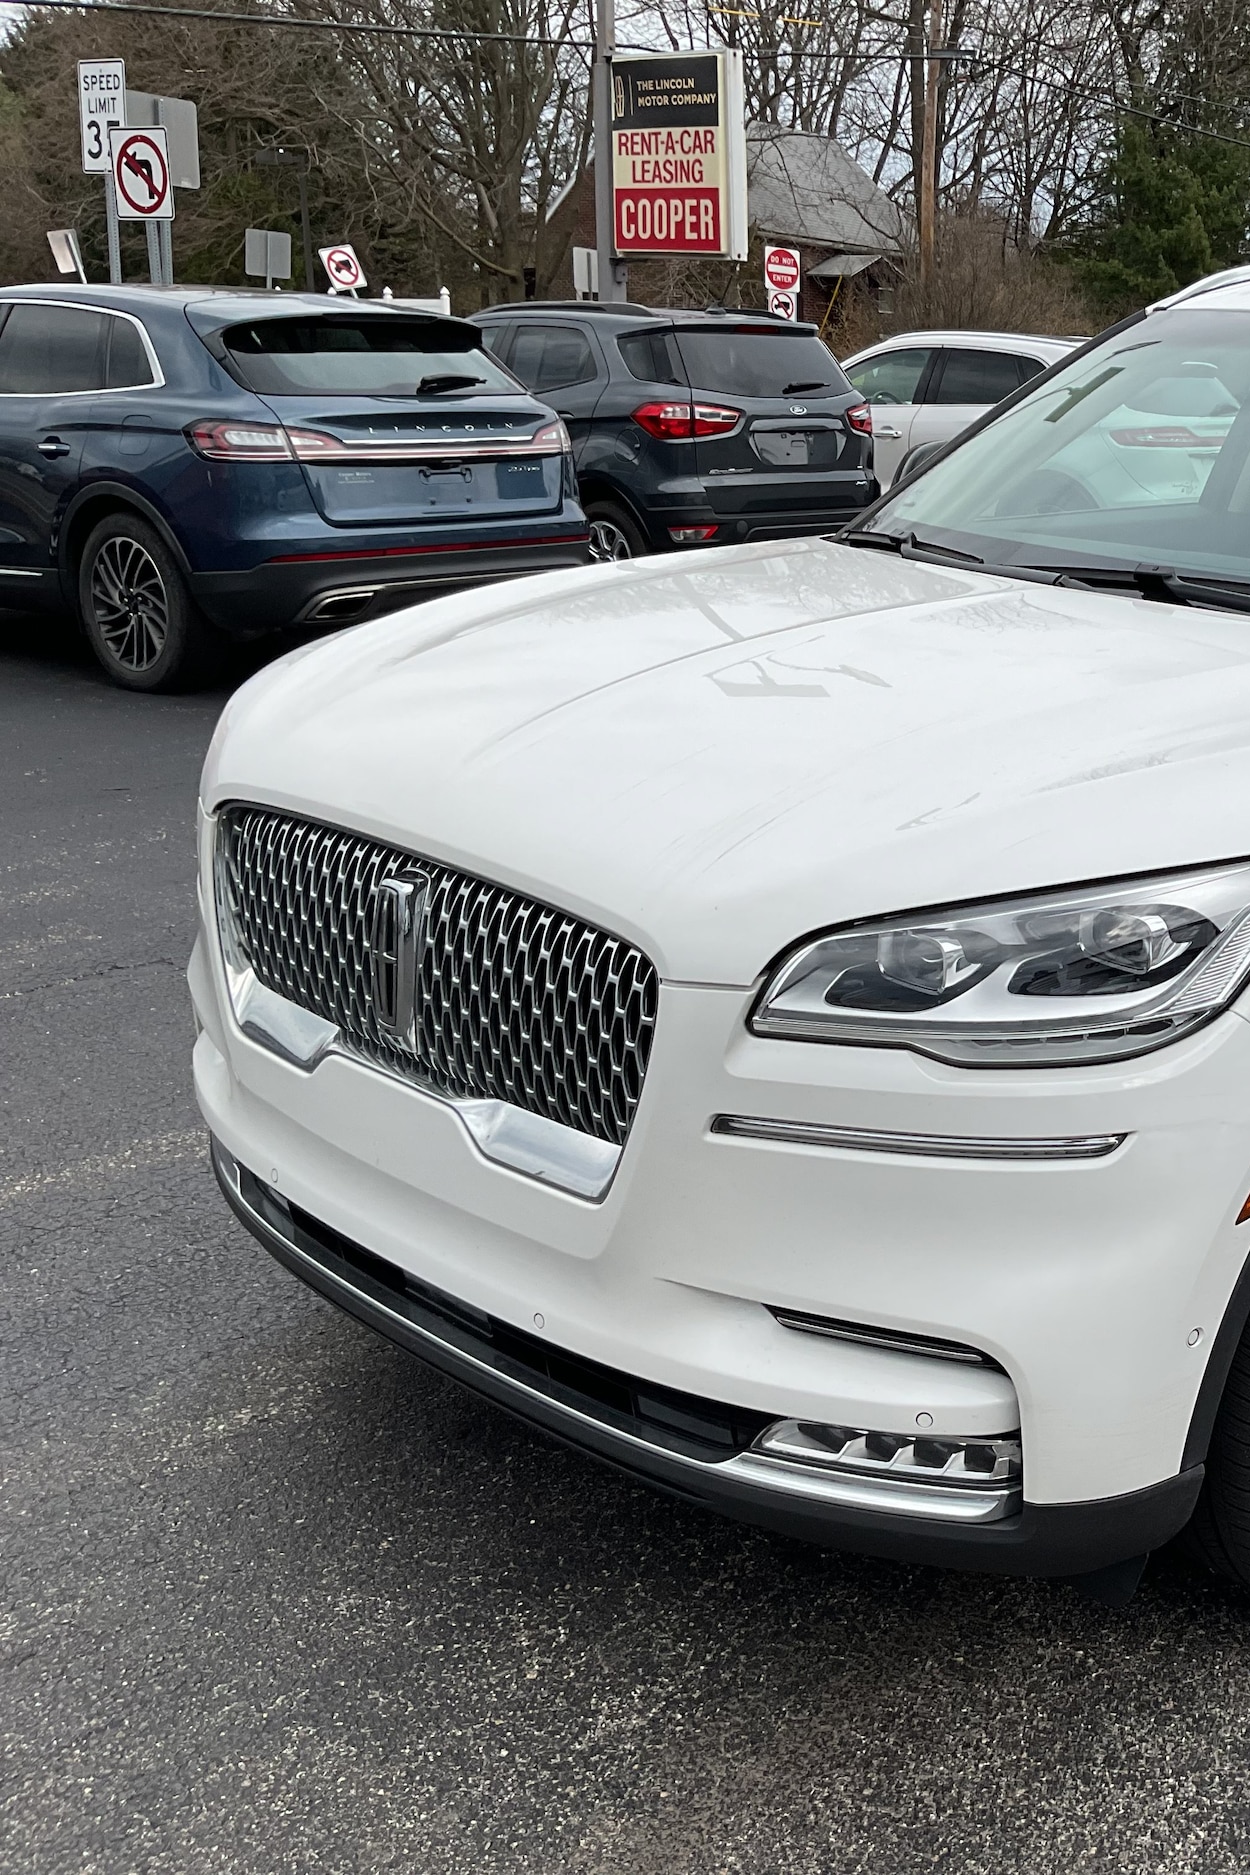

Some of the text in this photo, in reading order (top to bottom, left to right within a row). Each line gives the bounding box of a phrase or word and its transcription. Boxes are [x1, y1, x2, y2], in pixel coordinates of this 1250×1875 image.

[83, 74, 120, 91] SPEED
[636, 78, 695, 90] THE LINCOLN
[88, 98, 117, 114] LIMIT
[637, 92, 717, 107] MOTOR COMPANY
[87, 120, 120, 159] 3
[617, 130, 716, 156] RENT-A-CAR
[632, 158, 704, 184] LEASING
[621, 198, 715, 240] COOPER
[770, 255, 795, 266] DO NOT
[772, 273, 793, 284] ENTER
[369, 422, 513, 434] LINCOLN
